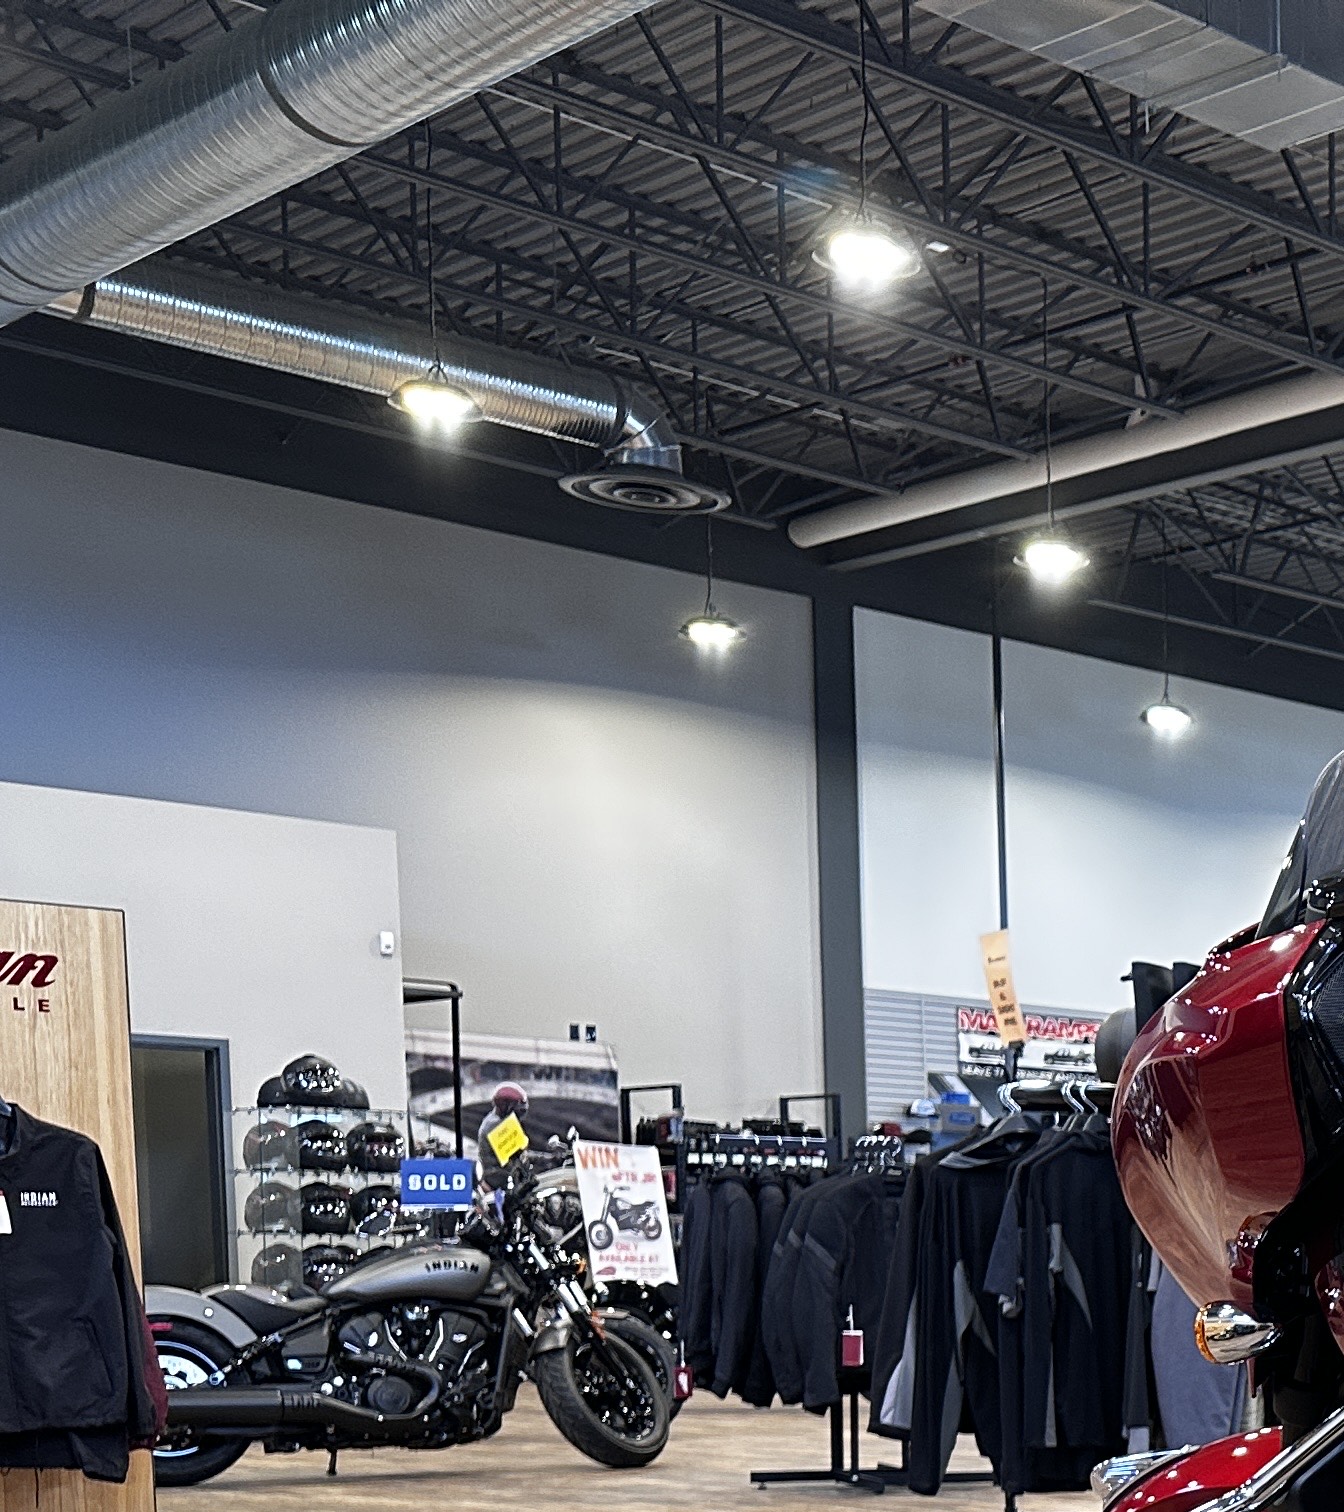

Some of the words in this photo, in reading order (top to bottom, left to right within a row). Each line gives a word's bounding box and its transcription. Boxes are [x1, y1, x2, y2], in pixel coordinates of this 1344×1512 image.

[577, 1146, 619, 1170] WIN
[408, 1174, 466, 1191] SOLD
[425, 1260, 479, 1274] INDIAN
